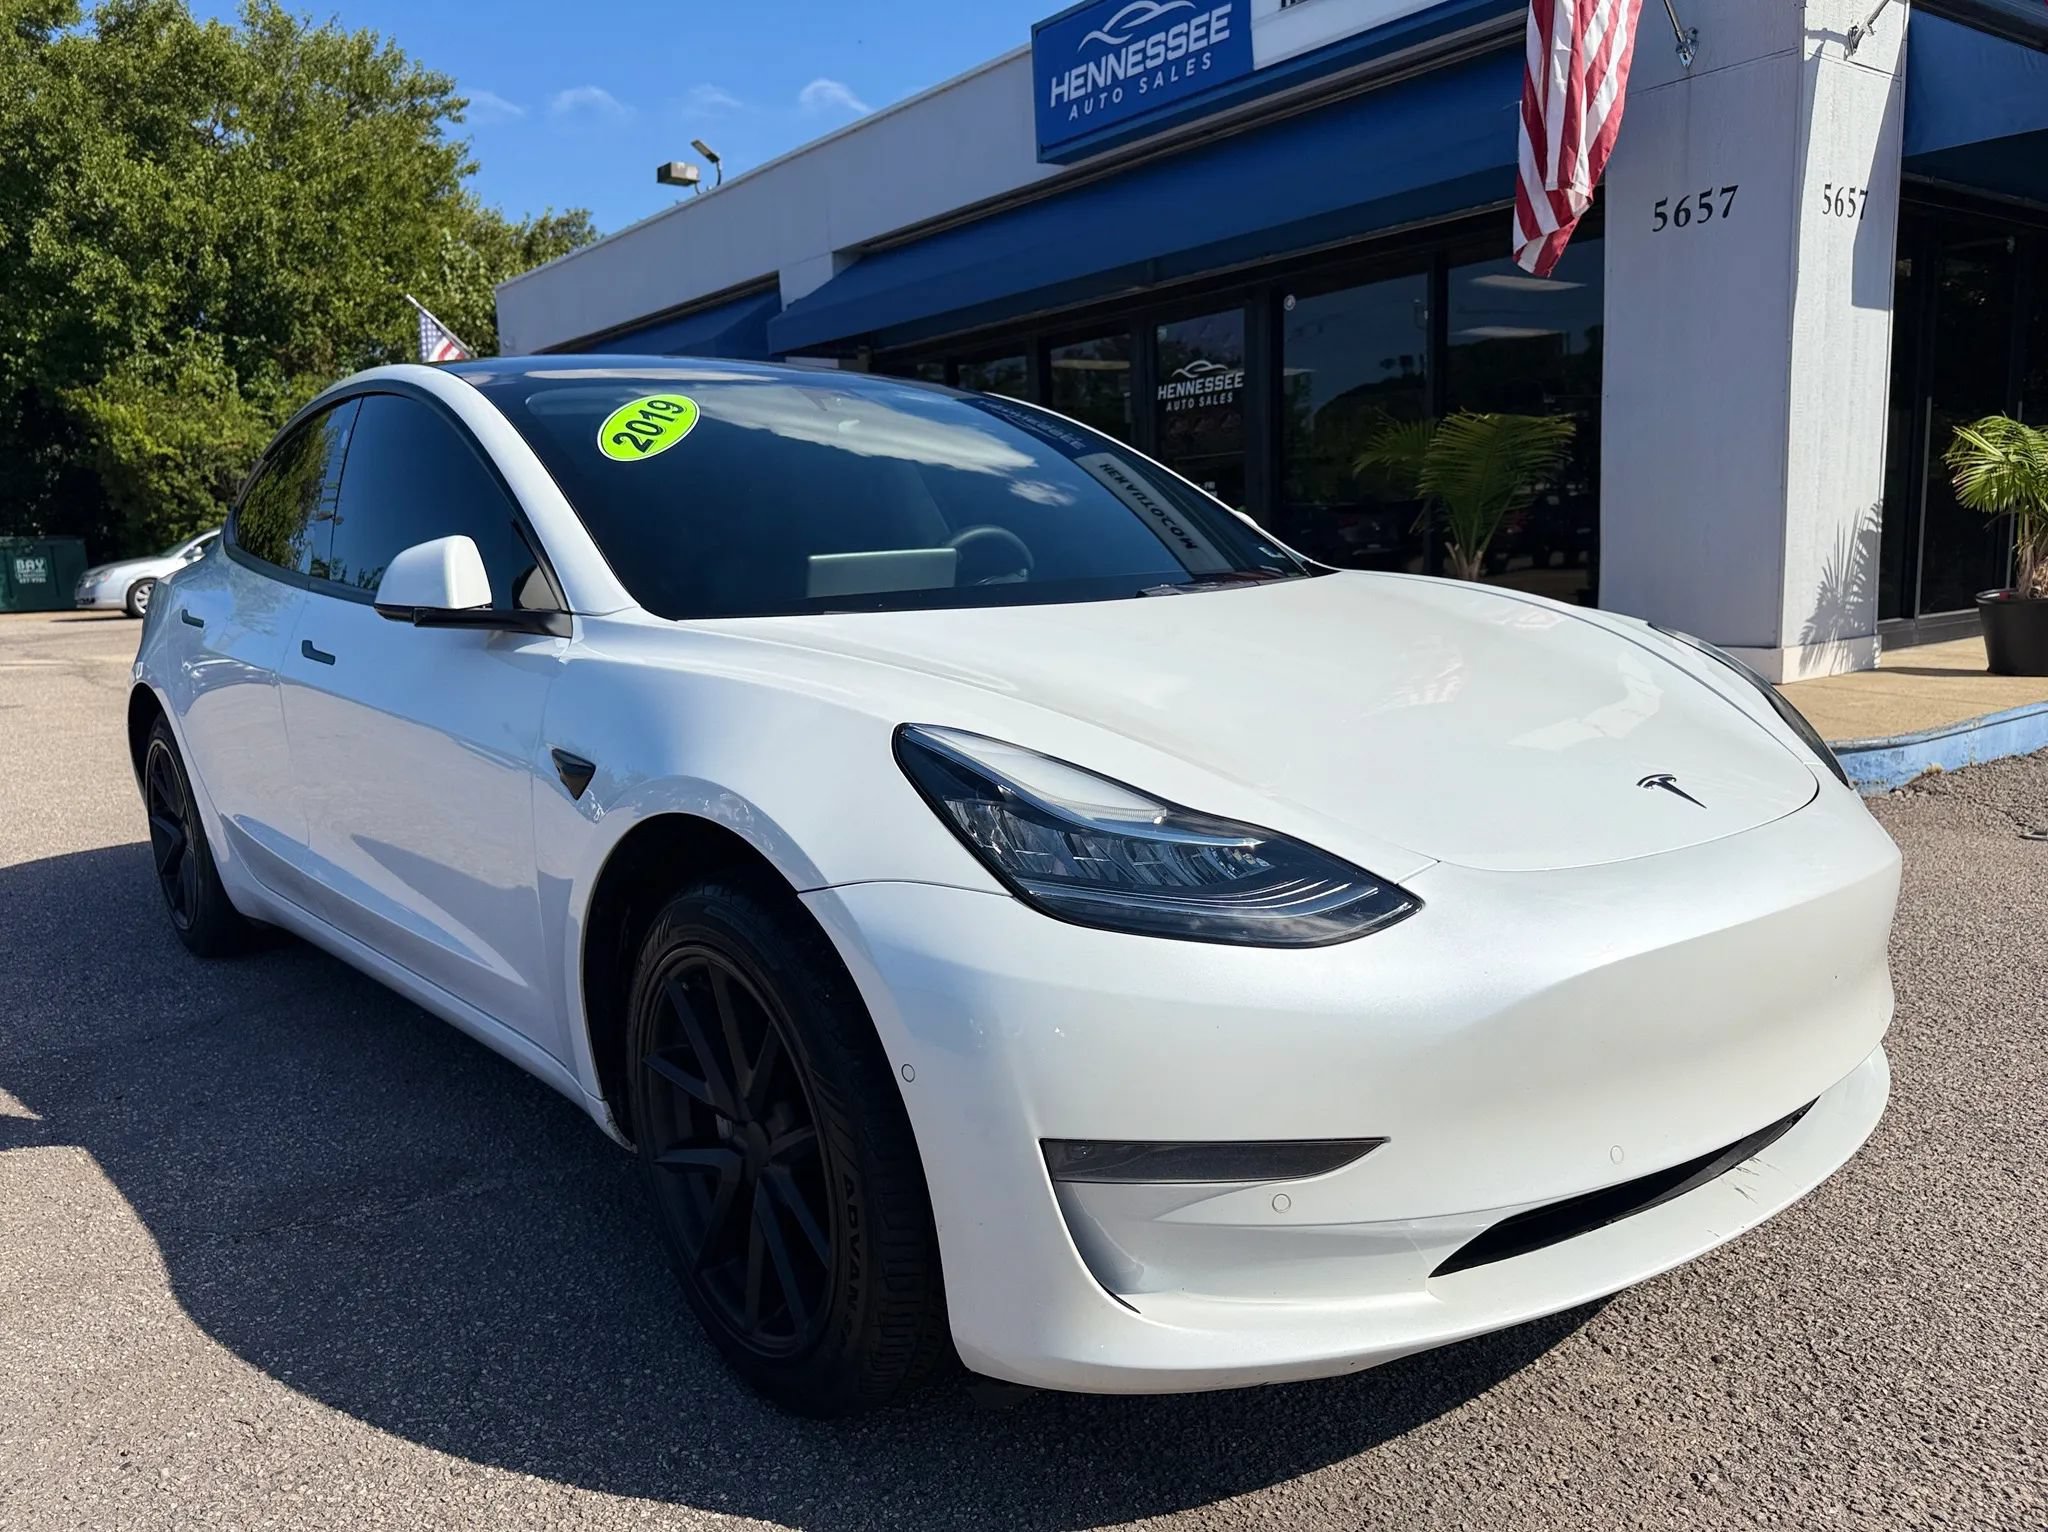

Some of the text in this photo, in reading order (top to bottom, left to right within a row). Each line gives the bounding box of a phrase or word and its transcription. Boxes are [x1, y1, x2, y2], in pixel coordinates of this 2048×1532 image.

[1050, 3, 1232, 108] HENNESSEE
[1069, 52, 1212, 121] AUTO SALES
[1652, 185, 1739, 232] 5657
[1822, 182, 1869, 220] 5657
[1157, 372, 1245, 400] HENNESSEE
[1166, 392, 1233, 412] AUTO SALES
[612, 400, 685, 453] 2019
[16, 558, 45, 570] BAY
